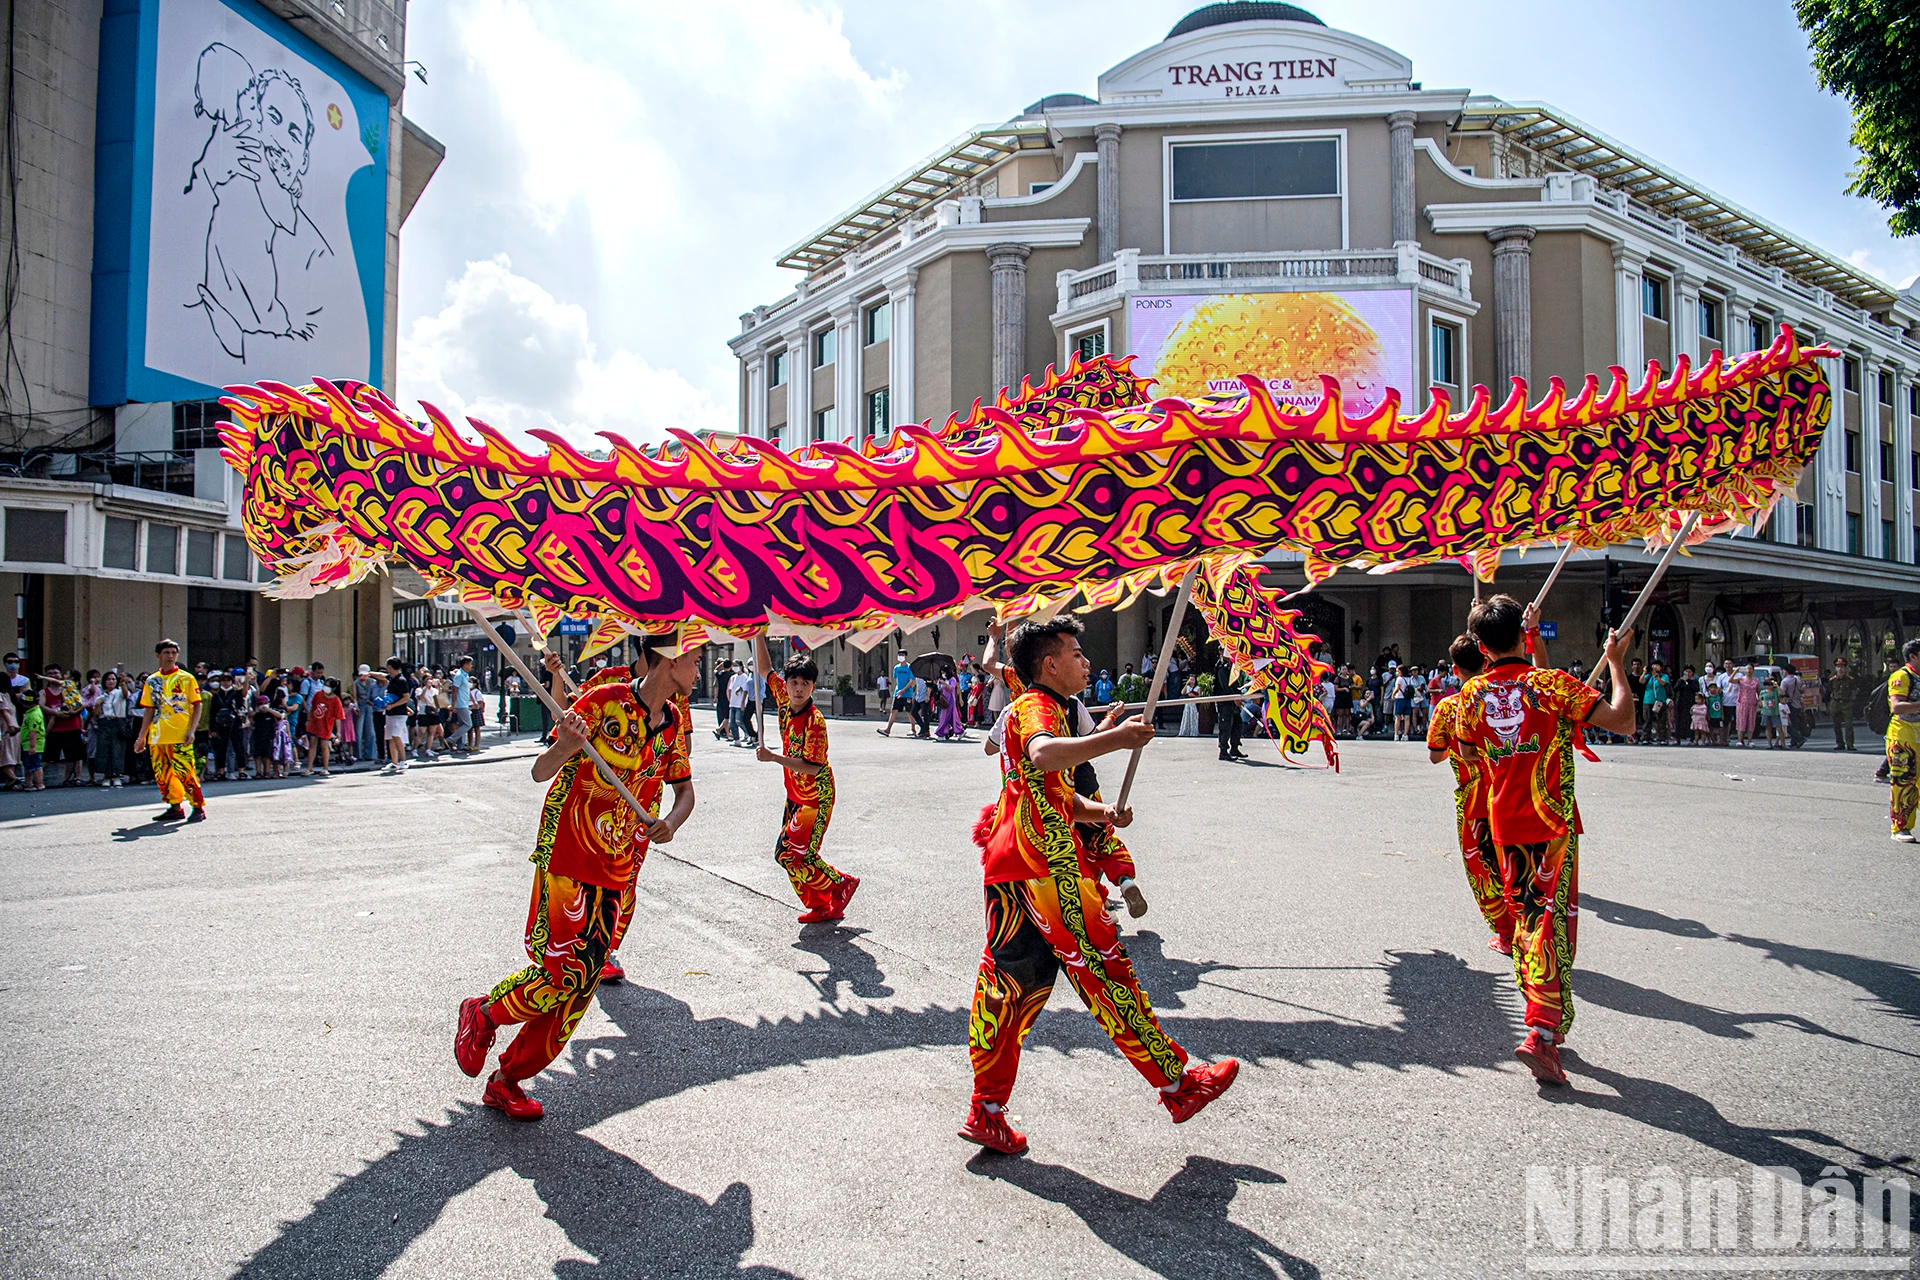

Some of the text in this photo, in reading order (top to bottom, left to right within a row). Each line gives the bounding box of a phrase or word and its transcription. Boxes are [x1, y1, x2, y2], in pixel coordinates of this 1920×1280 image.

[1168, 58, 1337, 87] TRANG TIEN
[1225, 84, 1281, 97] PLAZA
[1136, 299, 1172, 309] POND'S
[1269, 379, 1279, 390] C
[1282, 379, 1292, 390] &
